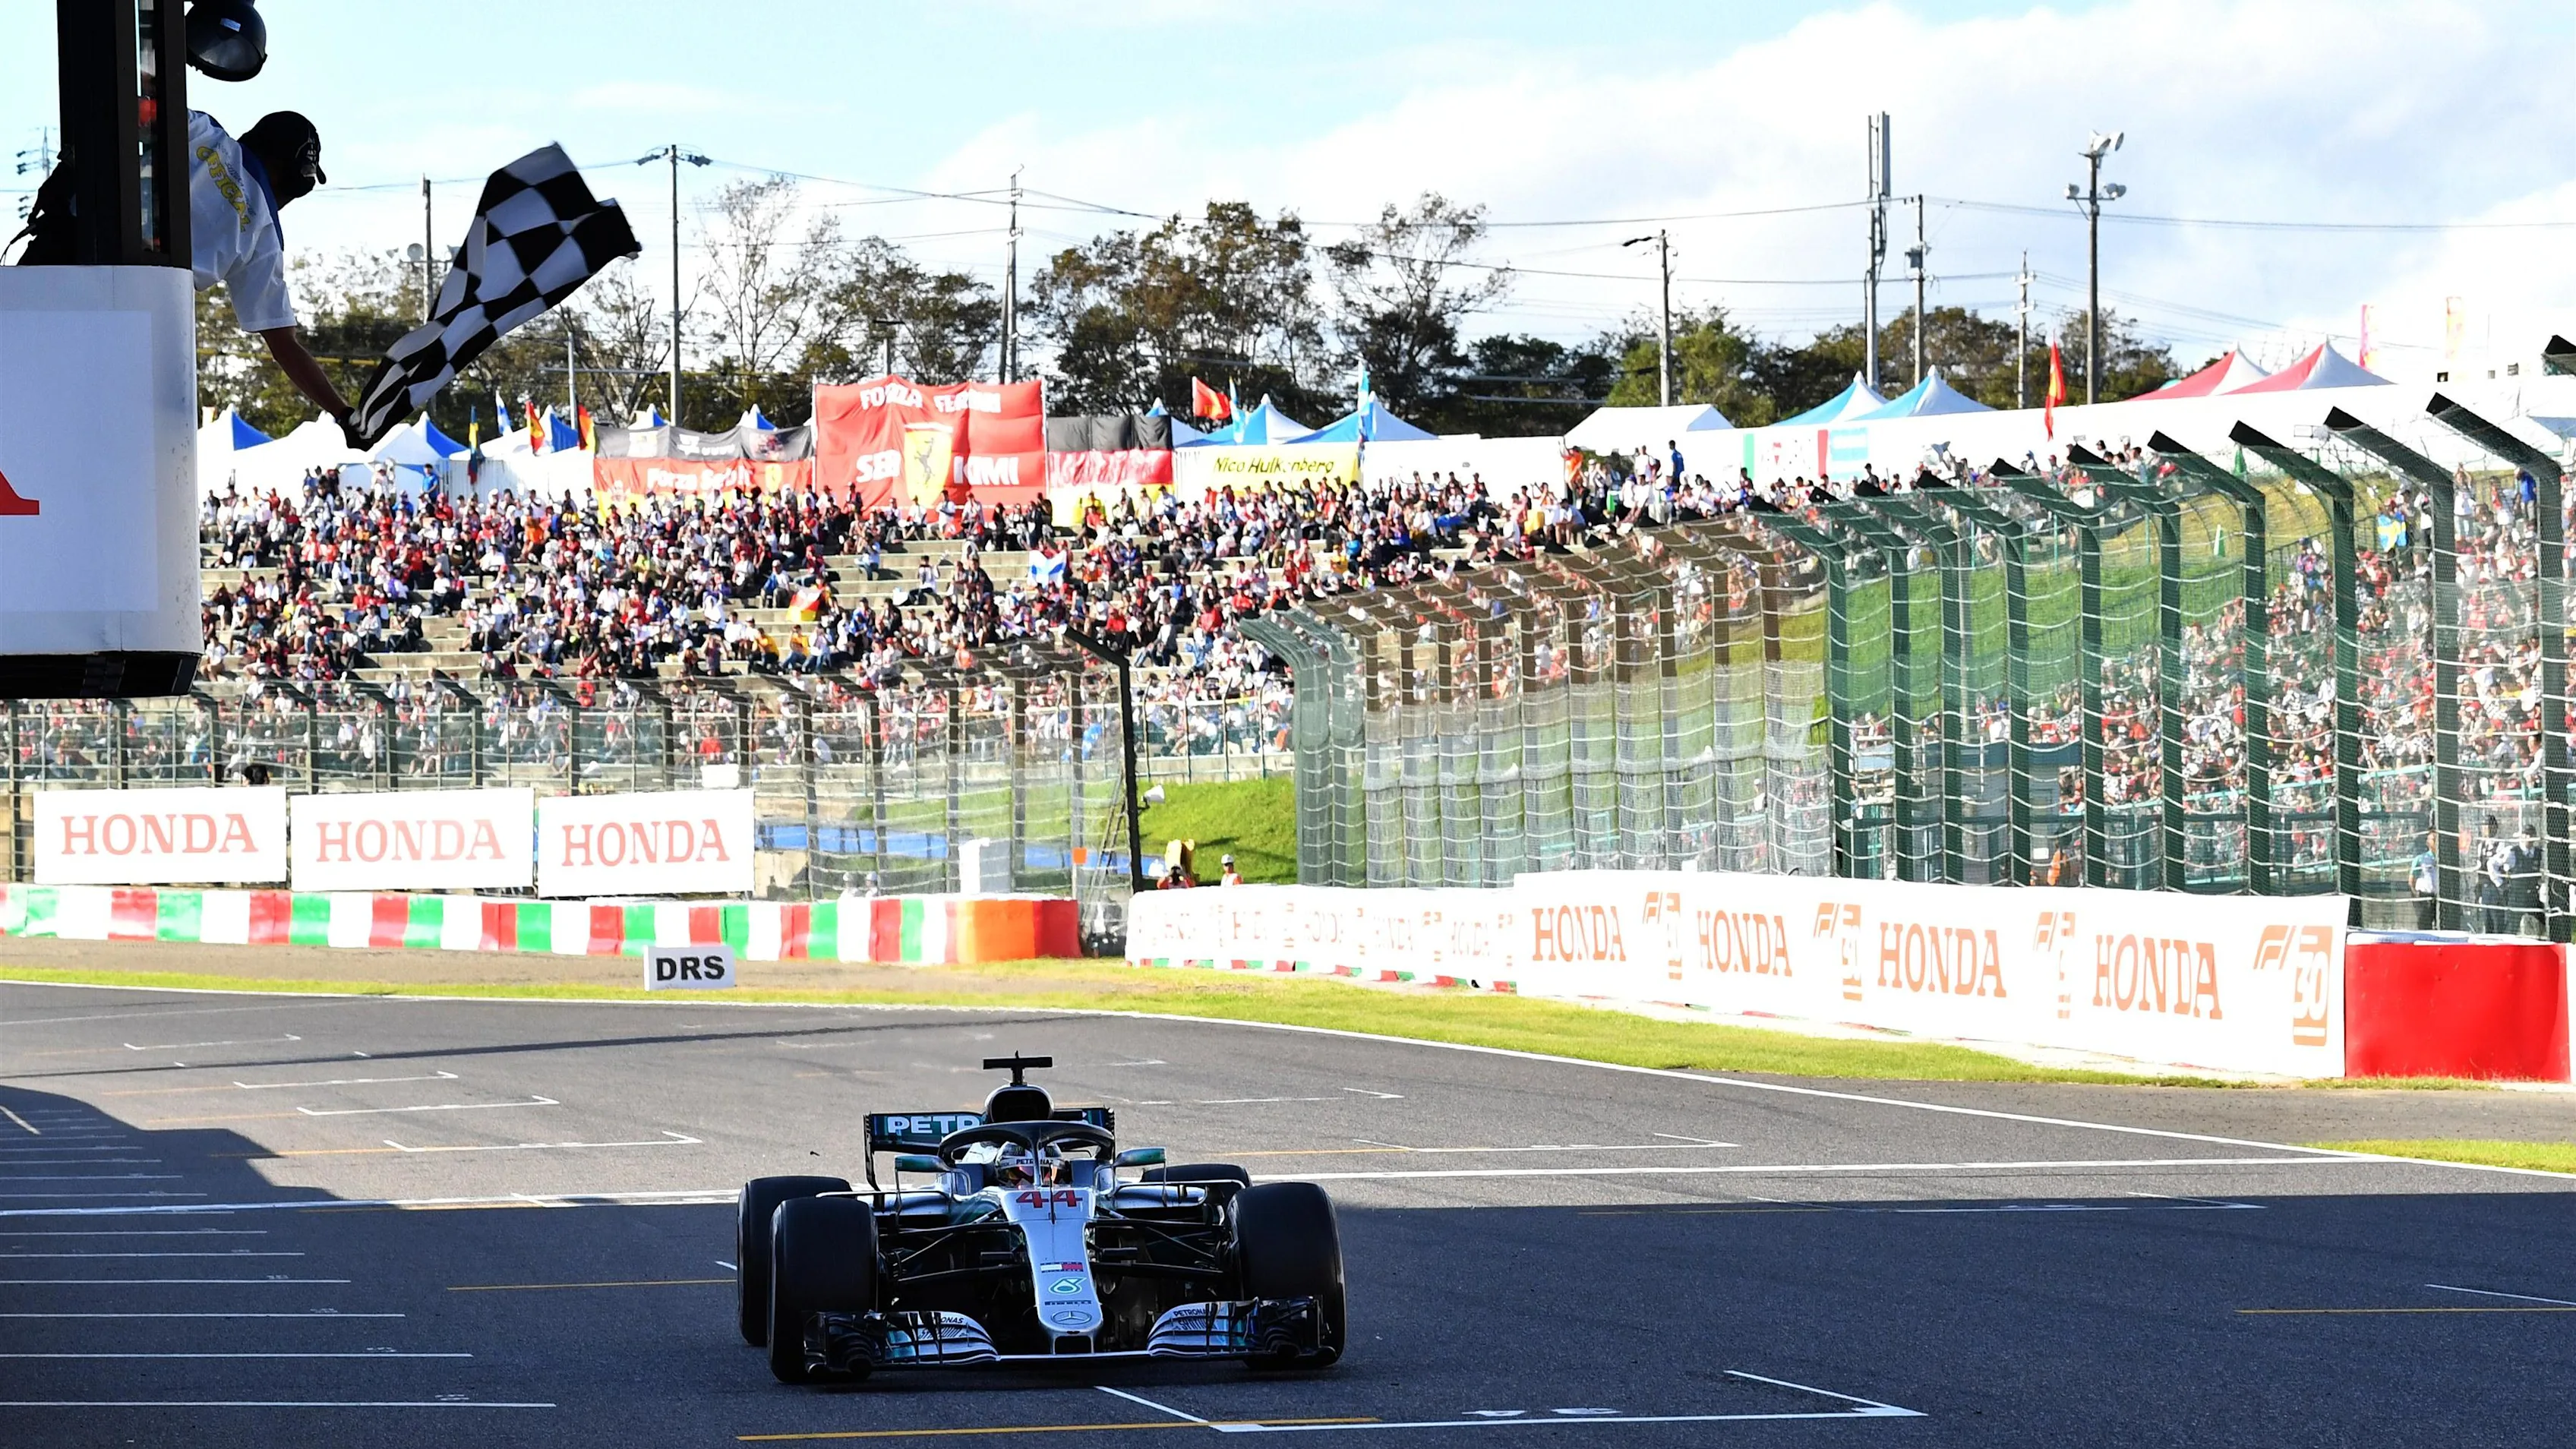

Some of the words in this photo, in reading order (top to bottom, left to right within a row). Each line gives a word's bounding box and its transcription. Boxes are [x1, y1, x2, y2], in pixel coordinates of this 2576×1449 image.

[1213, 457, 1245, 472] Nico
[1248, 457, 1334, 474] Hulknberg
[60, 813, 259, 855] HONDA
[316, 819, 506, 862] HONDA
[561, 819, 730, 867] HONDA
[1532, 904, 1627, 962] HONDA
[1697, 910, 1792, 977] HONDA
[655, 955, 725, 981] DRS
[1877, 921, 2006, 998] HONDA
[2092, 933, 2223, 1020] HONDA
[1015, 1190, 1083, 1208] 44
